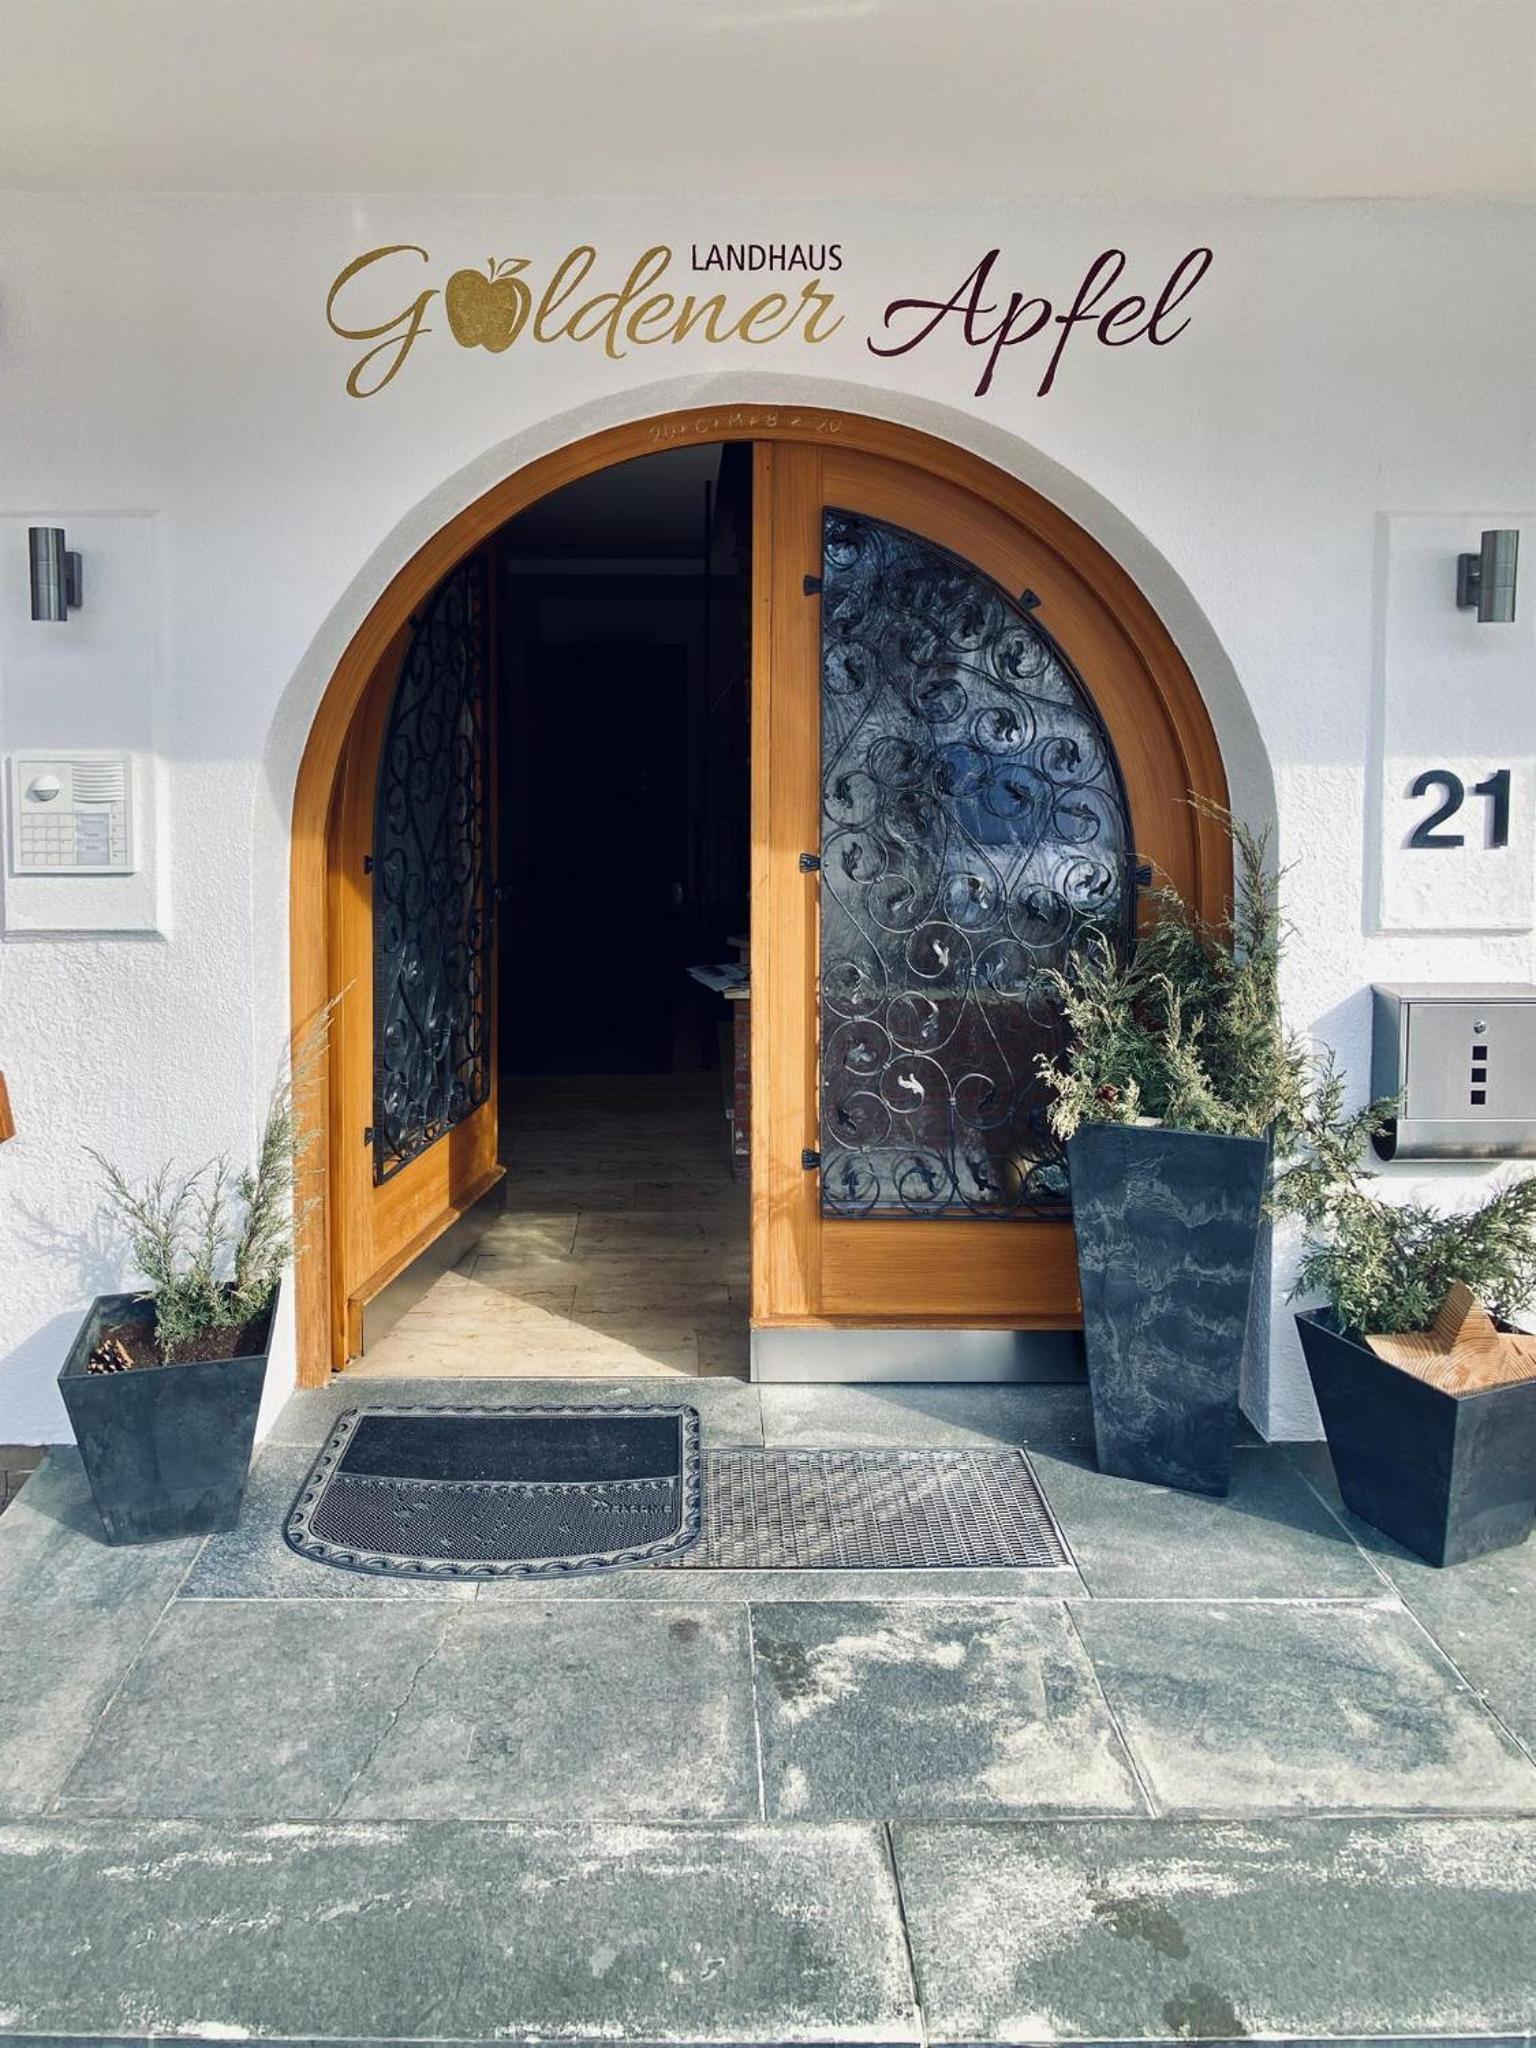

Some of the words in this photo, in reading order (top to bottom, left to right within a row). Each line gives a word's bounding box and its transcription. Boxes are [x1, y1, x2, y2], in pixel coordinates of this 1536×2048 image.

[692, 244, 843, 271] LANDHAUS
[866, 247, 1214, 398] Apfel
[1409, 768, 1512, 849] 21
